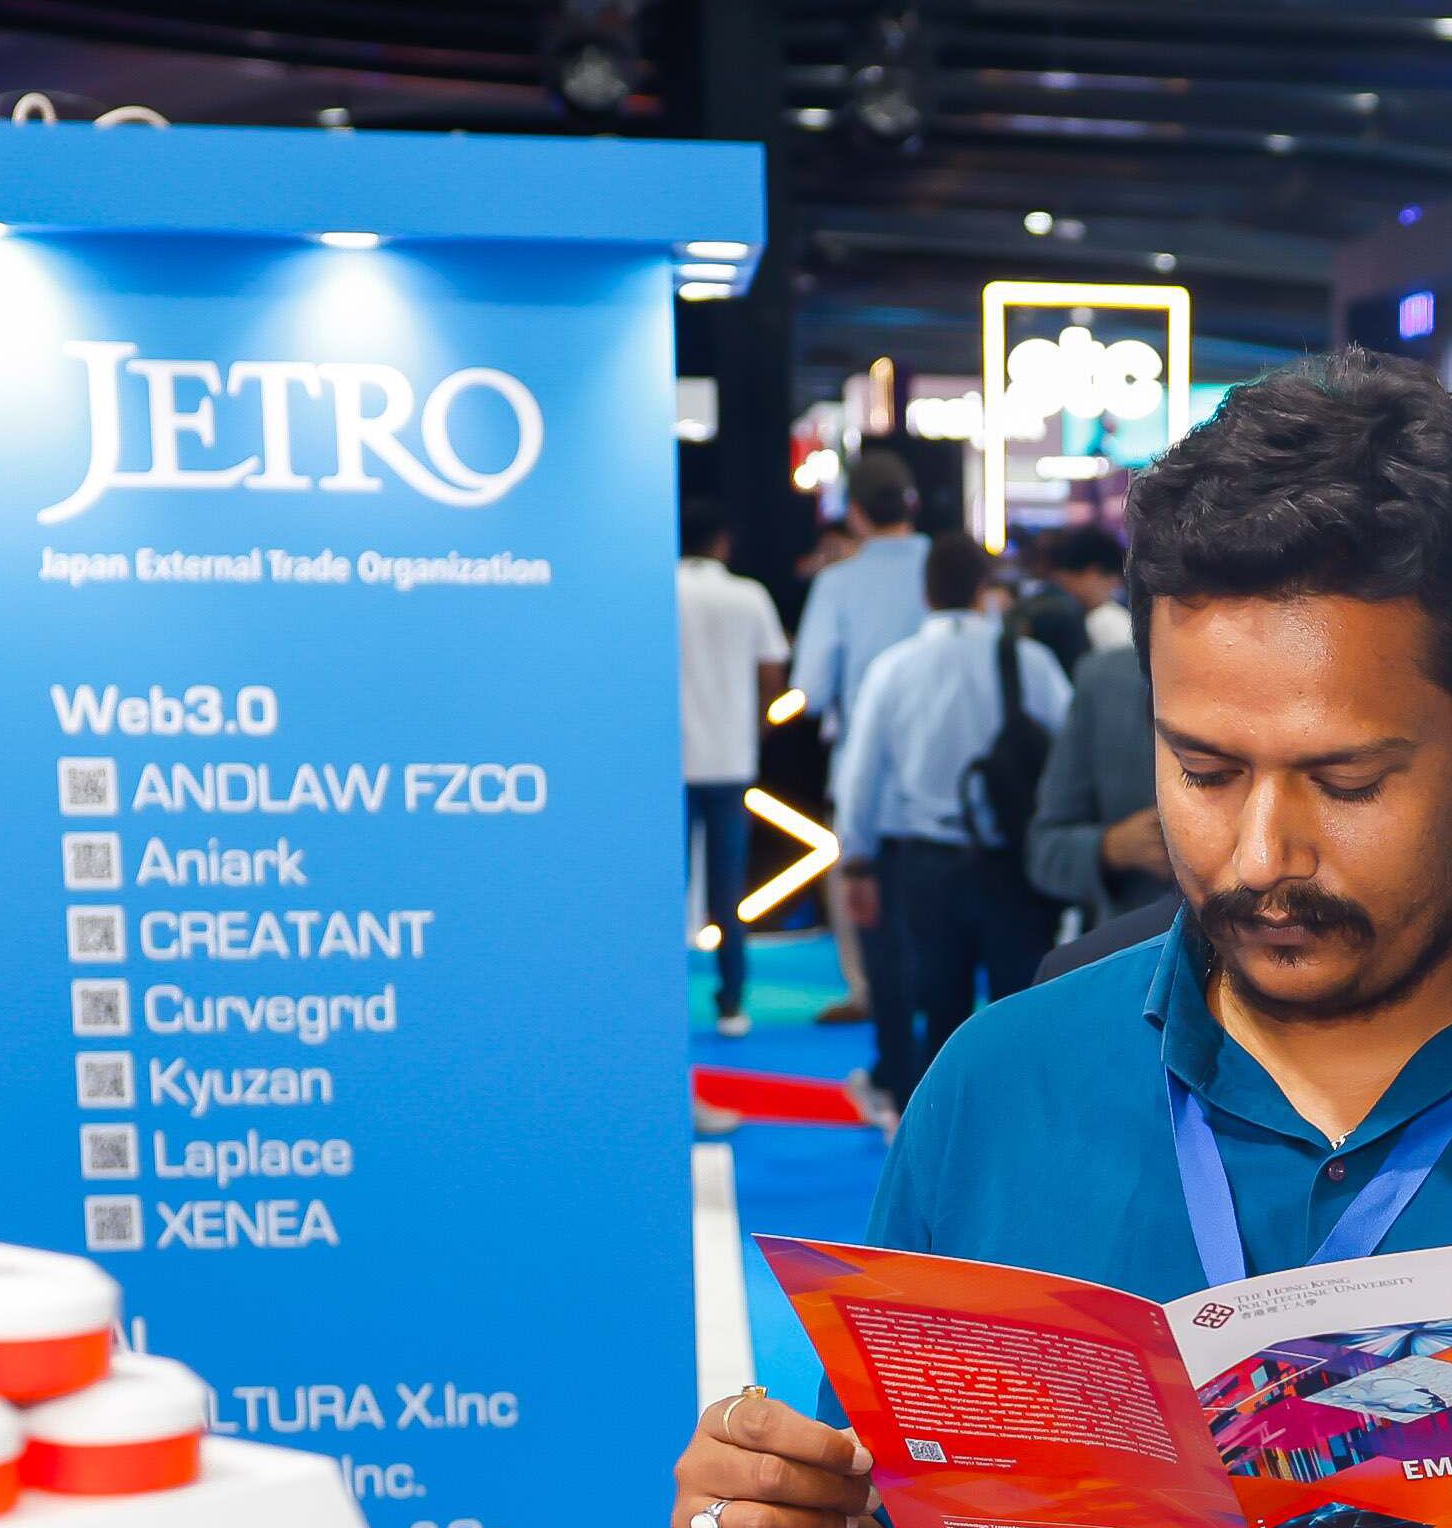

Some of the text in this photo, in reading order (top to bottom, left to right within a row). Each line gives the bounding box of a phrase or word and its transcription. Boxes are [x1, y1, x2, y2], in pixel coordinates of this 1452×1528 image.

[37, 340, 544, 526] JETRO
[38, 546, 552, 592] Japan External Trade Organization
[50, 684, 278, 737] Web3.0
[130, 761, 548, 814] ANDLAW FZCO
[135, 835, 308, 887] Aniark
[138, 909, 435, 961] CREATANT
[143, 982, 398, 1045] Curvegrid
[148, 1056, 334, 1118] Kyuzan
[152, 1128, 353, 1189] Laplace
[156, 1198, 340, 1249] XENEA
[208, 1381, 519, 1433] LTURA X.Inc
